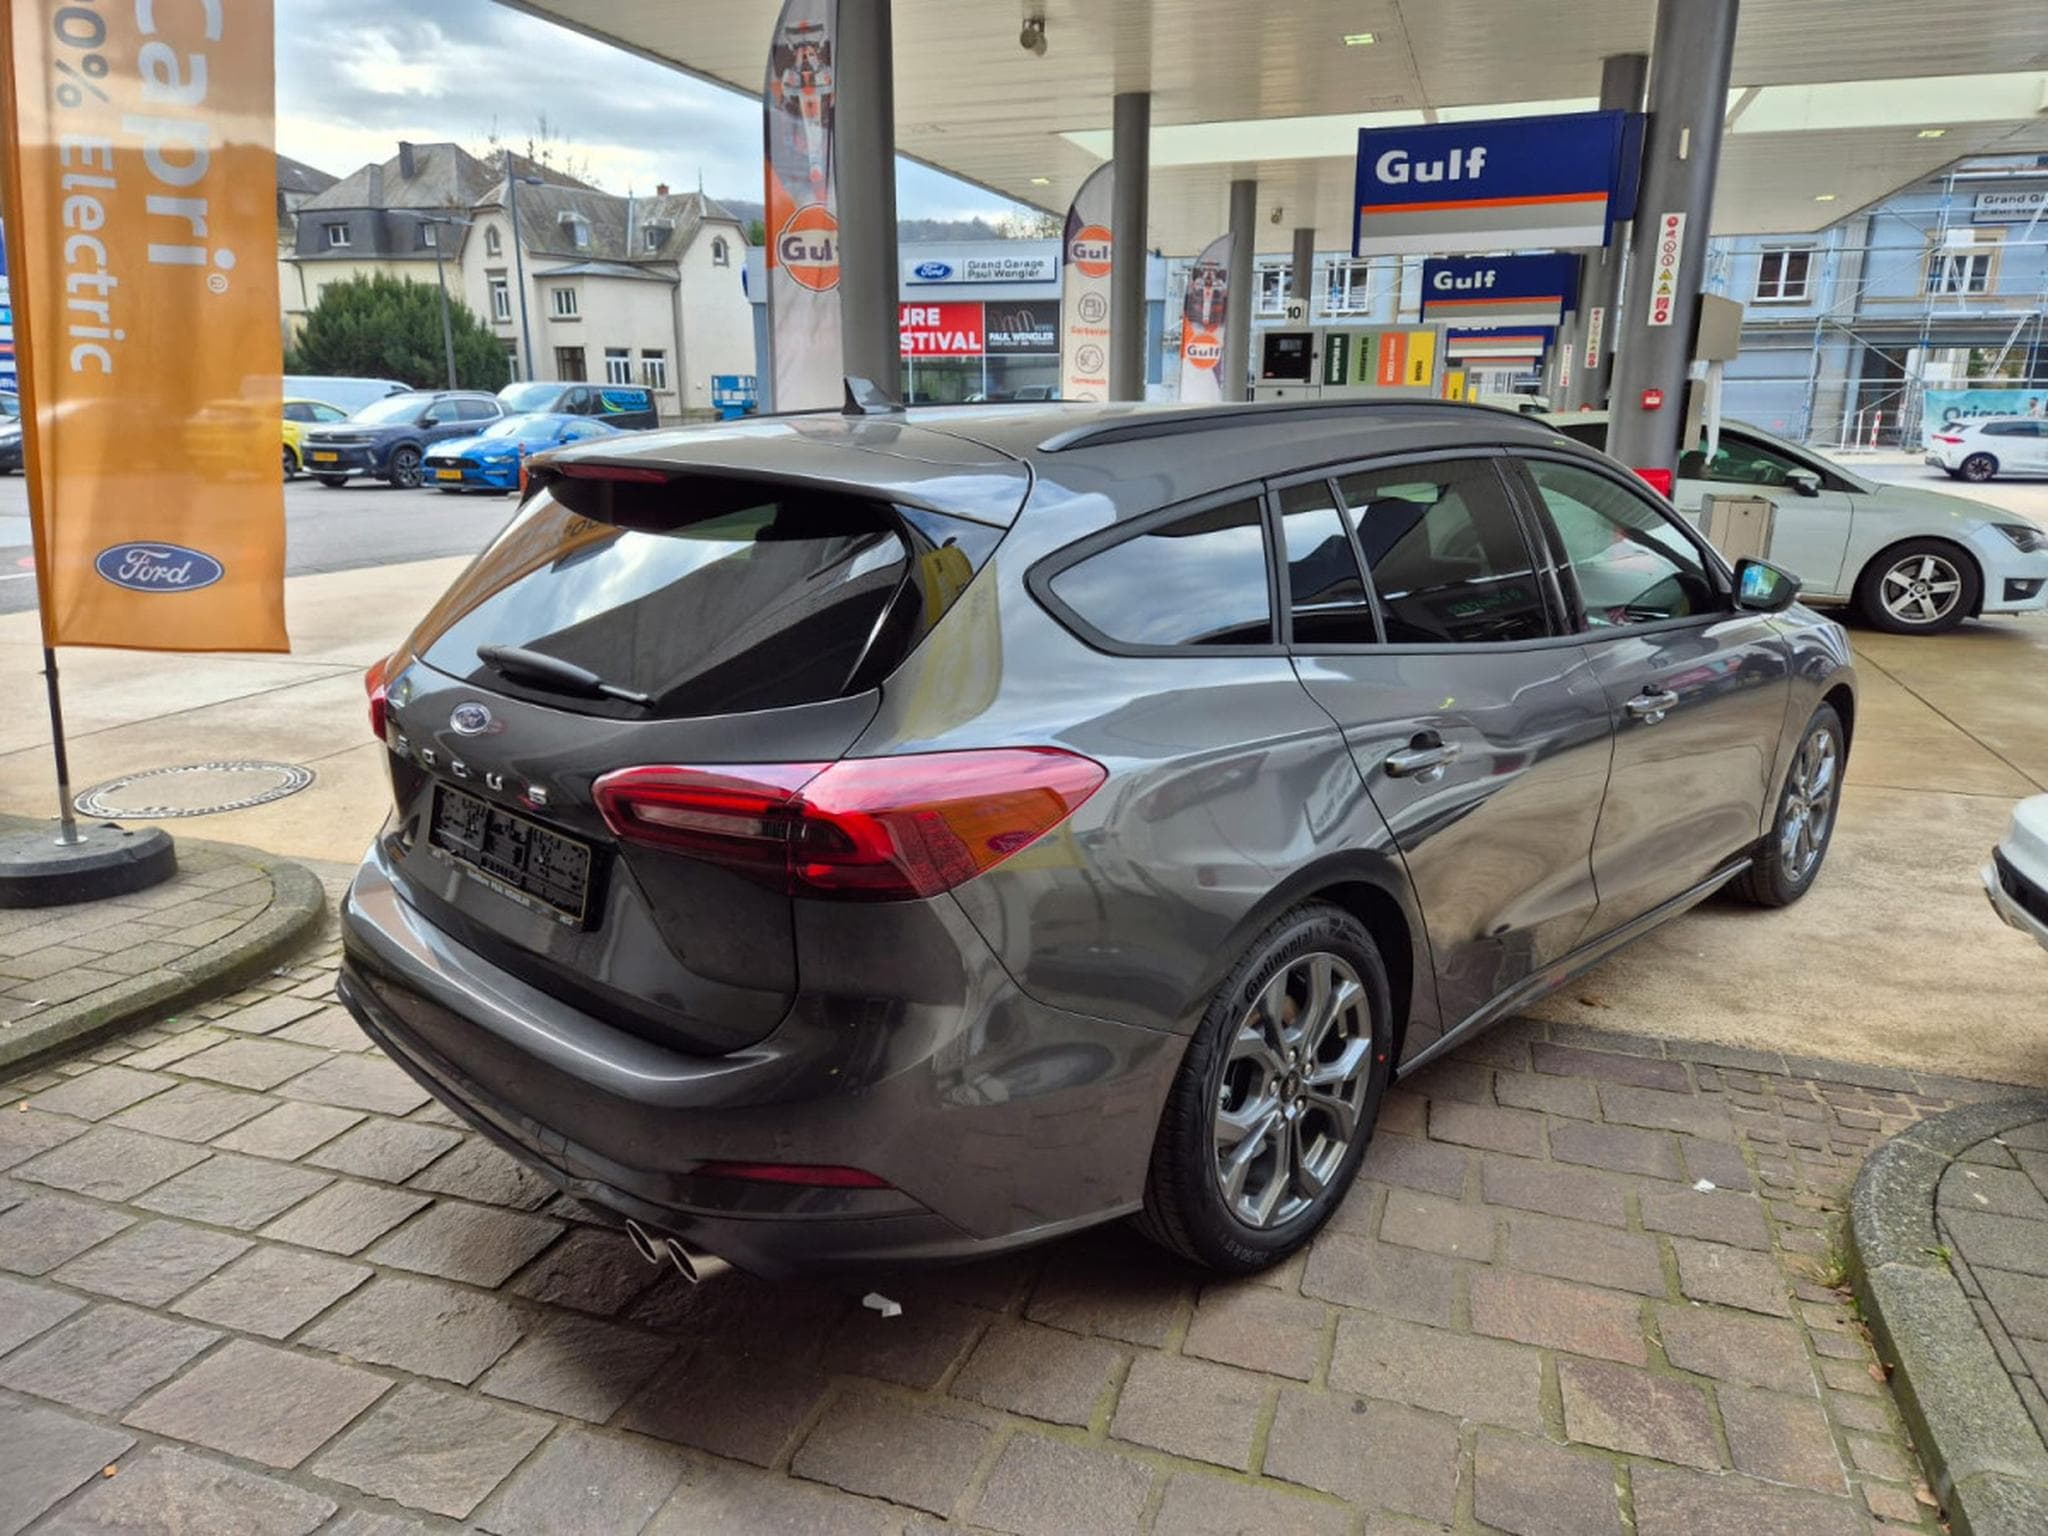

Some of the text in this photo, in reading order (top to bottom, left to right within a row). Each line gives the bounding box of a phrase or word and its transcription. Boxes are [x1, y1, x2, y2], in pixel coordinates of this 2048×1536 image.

[1375, 146, 1487, 184] Gulf
[53, 0, 126, 375] 0% Electric
[781, 236, 840, 261] Gul
[1073, 243, 1110, 259] Gul
[967, 259, 1044, 270] Grand Garage
[967, 269, 1040, 280] Paul Wengler
[1433, 270, 1496, 291] Gulf
[1287, 306, 1301, 319] 10
[988, 332, 1055, 341] PAUL WENGLER
[1187, 344, 1220, 358] Gulf
[118, 549, 192, 585] Ford
